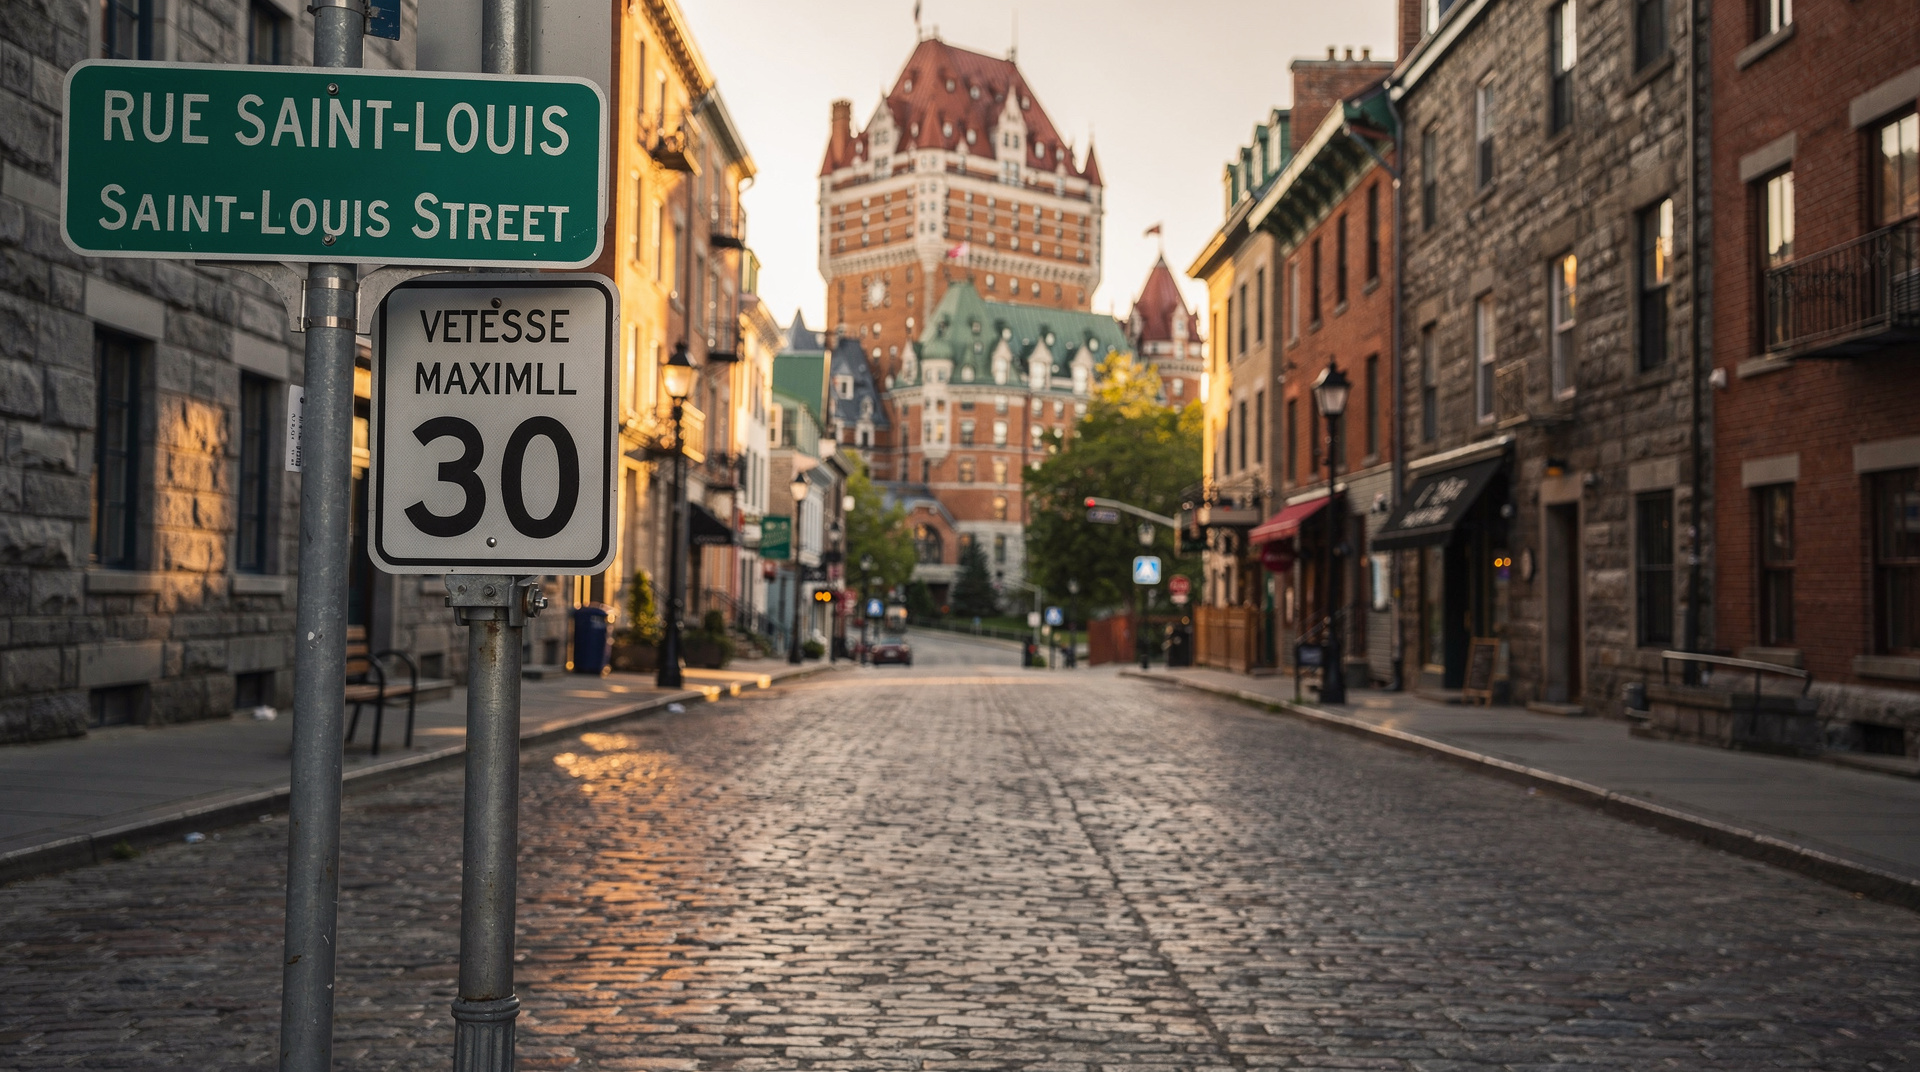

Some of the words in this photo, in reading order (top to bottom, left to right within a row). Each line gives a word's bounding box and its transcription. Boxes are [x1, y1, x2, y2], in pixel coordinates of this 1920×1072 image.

[103, 89, 210, 144] RUE
[234, 93, 570, 157] SAINT-LOUIS
[415, 362, 577, 396] MAXIMLL
[404, 415, 580, 540] 30
